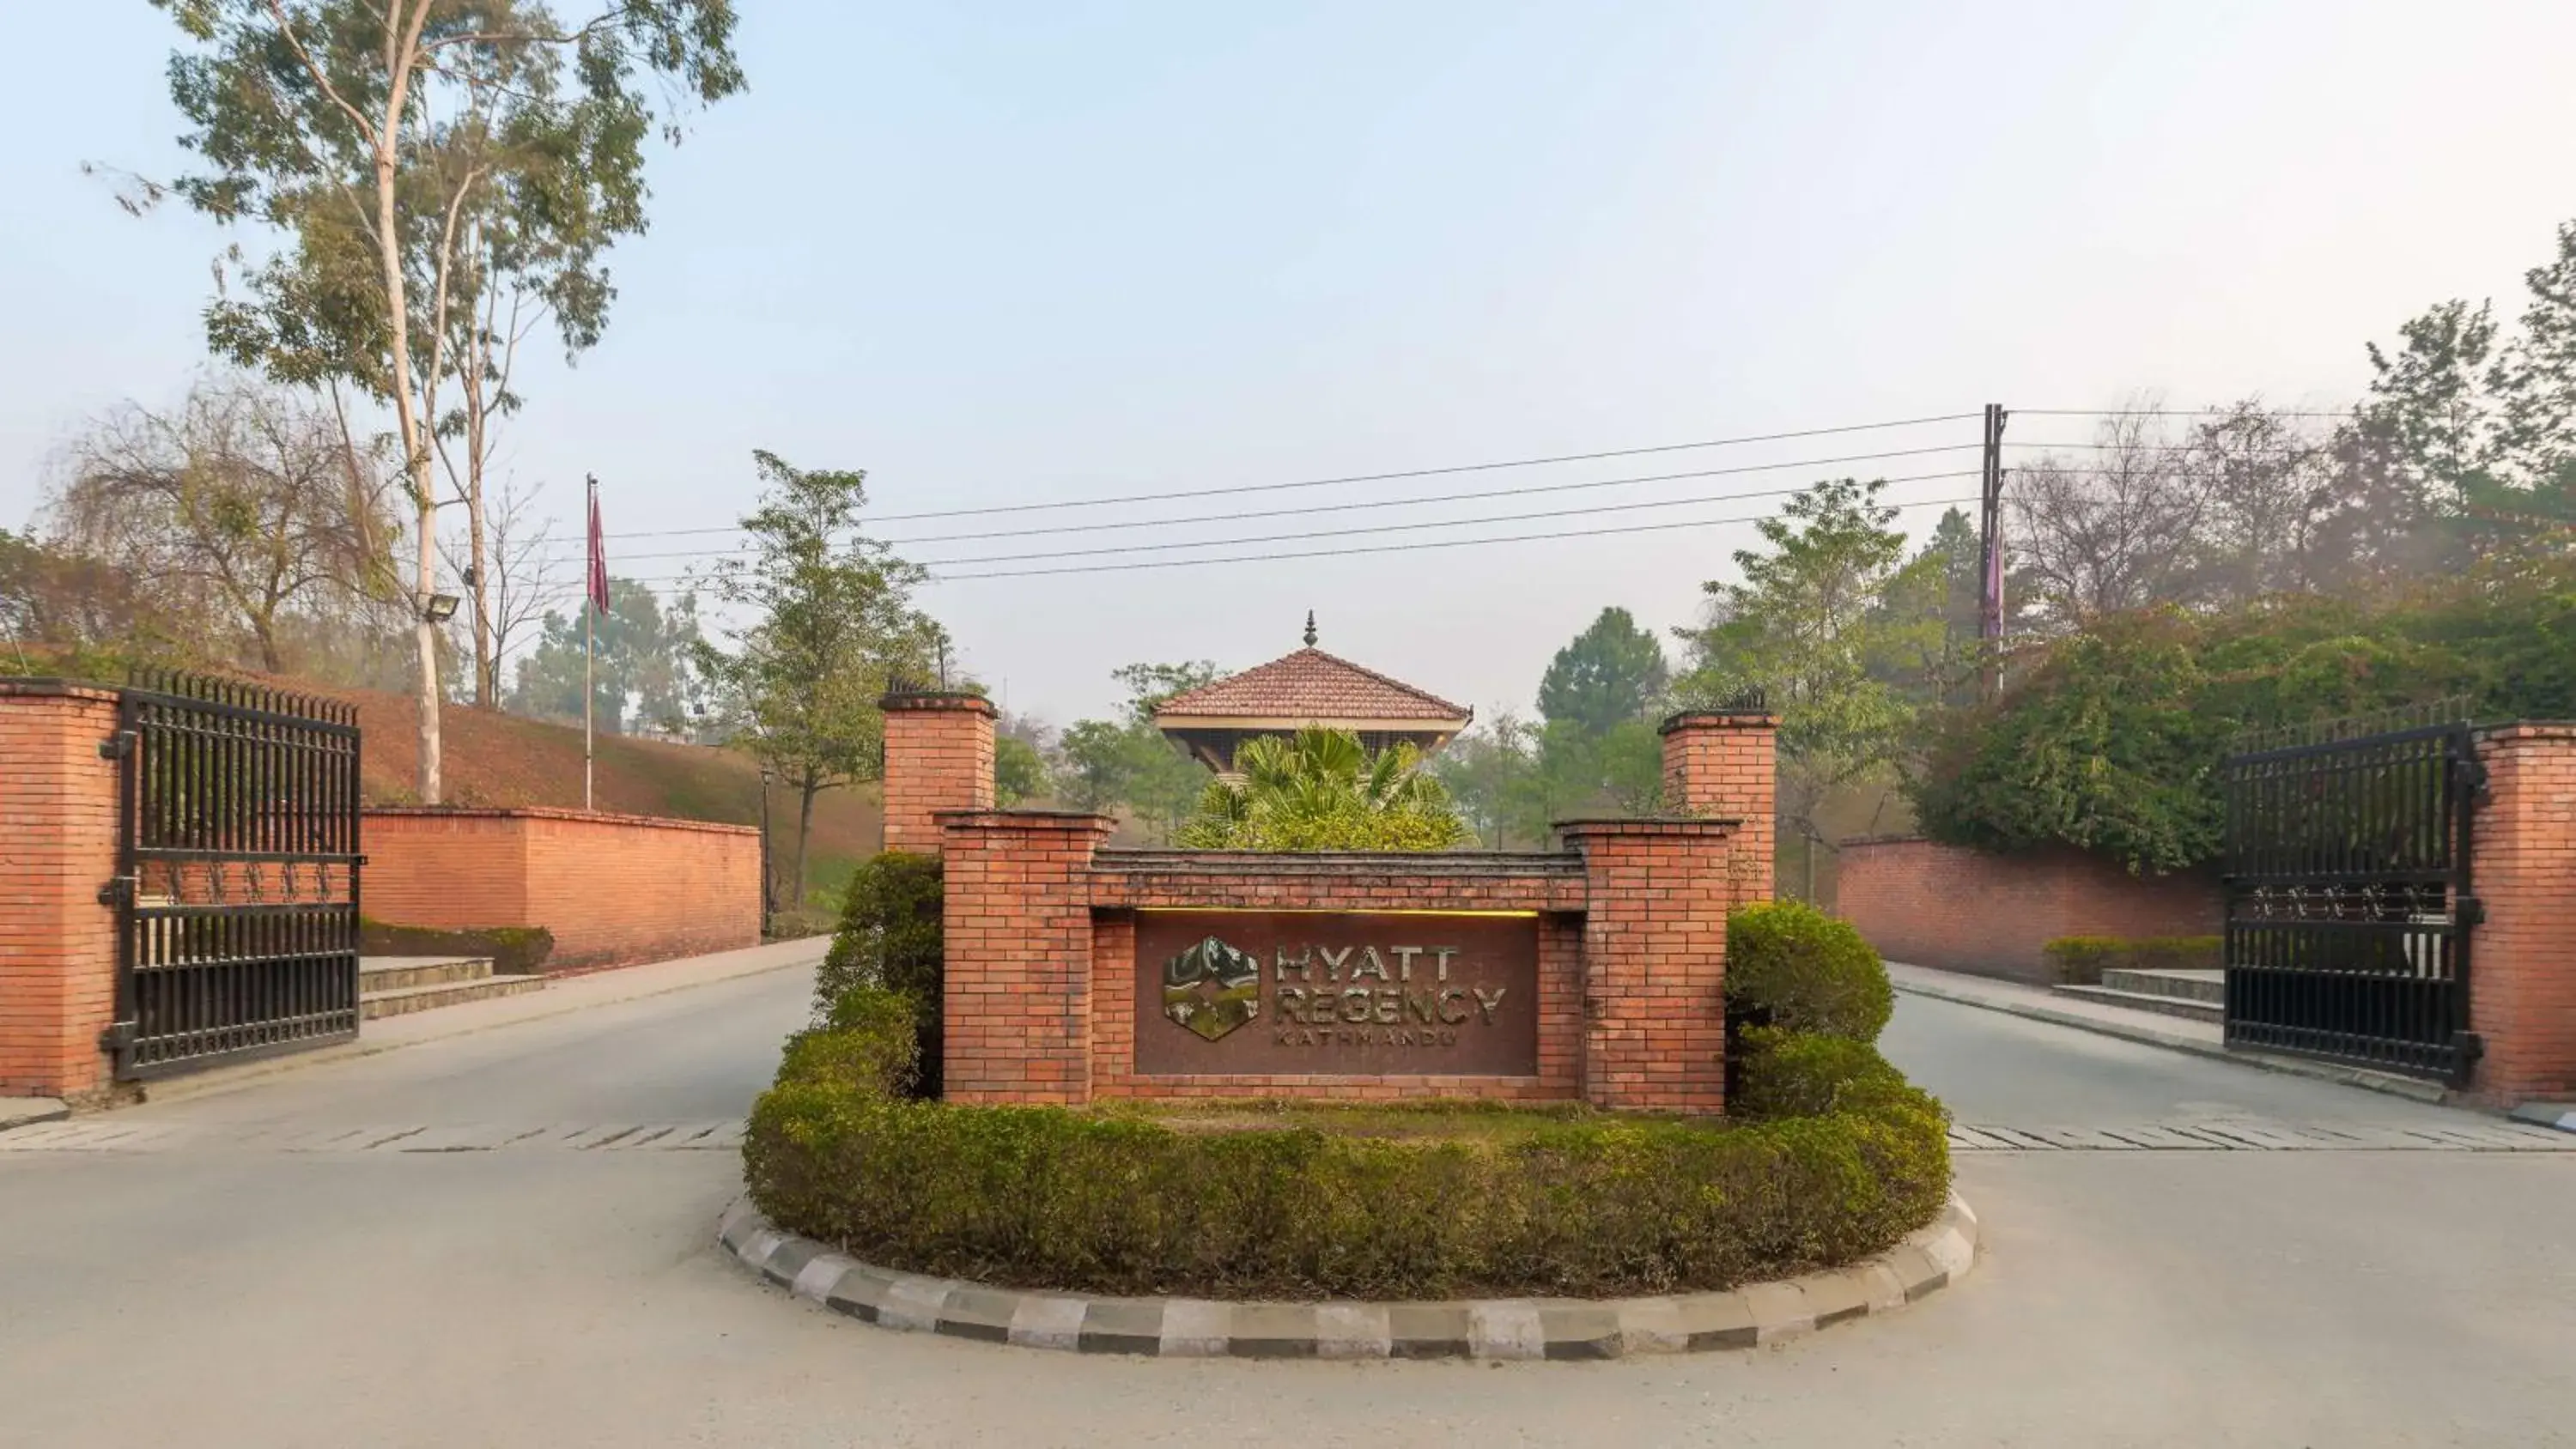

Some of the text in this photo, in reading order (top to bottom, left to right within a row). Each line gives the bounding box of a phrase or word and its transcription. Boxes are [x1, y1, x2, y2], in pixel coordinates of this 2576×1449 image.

[1276, 946, 1459, 982] HYATT
[1275, 987, 1507, 1026] REGENCY
[1277, 1029, 1458, 1047] KATHMANDU
